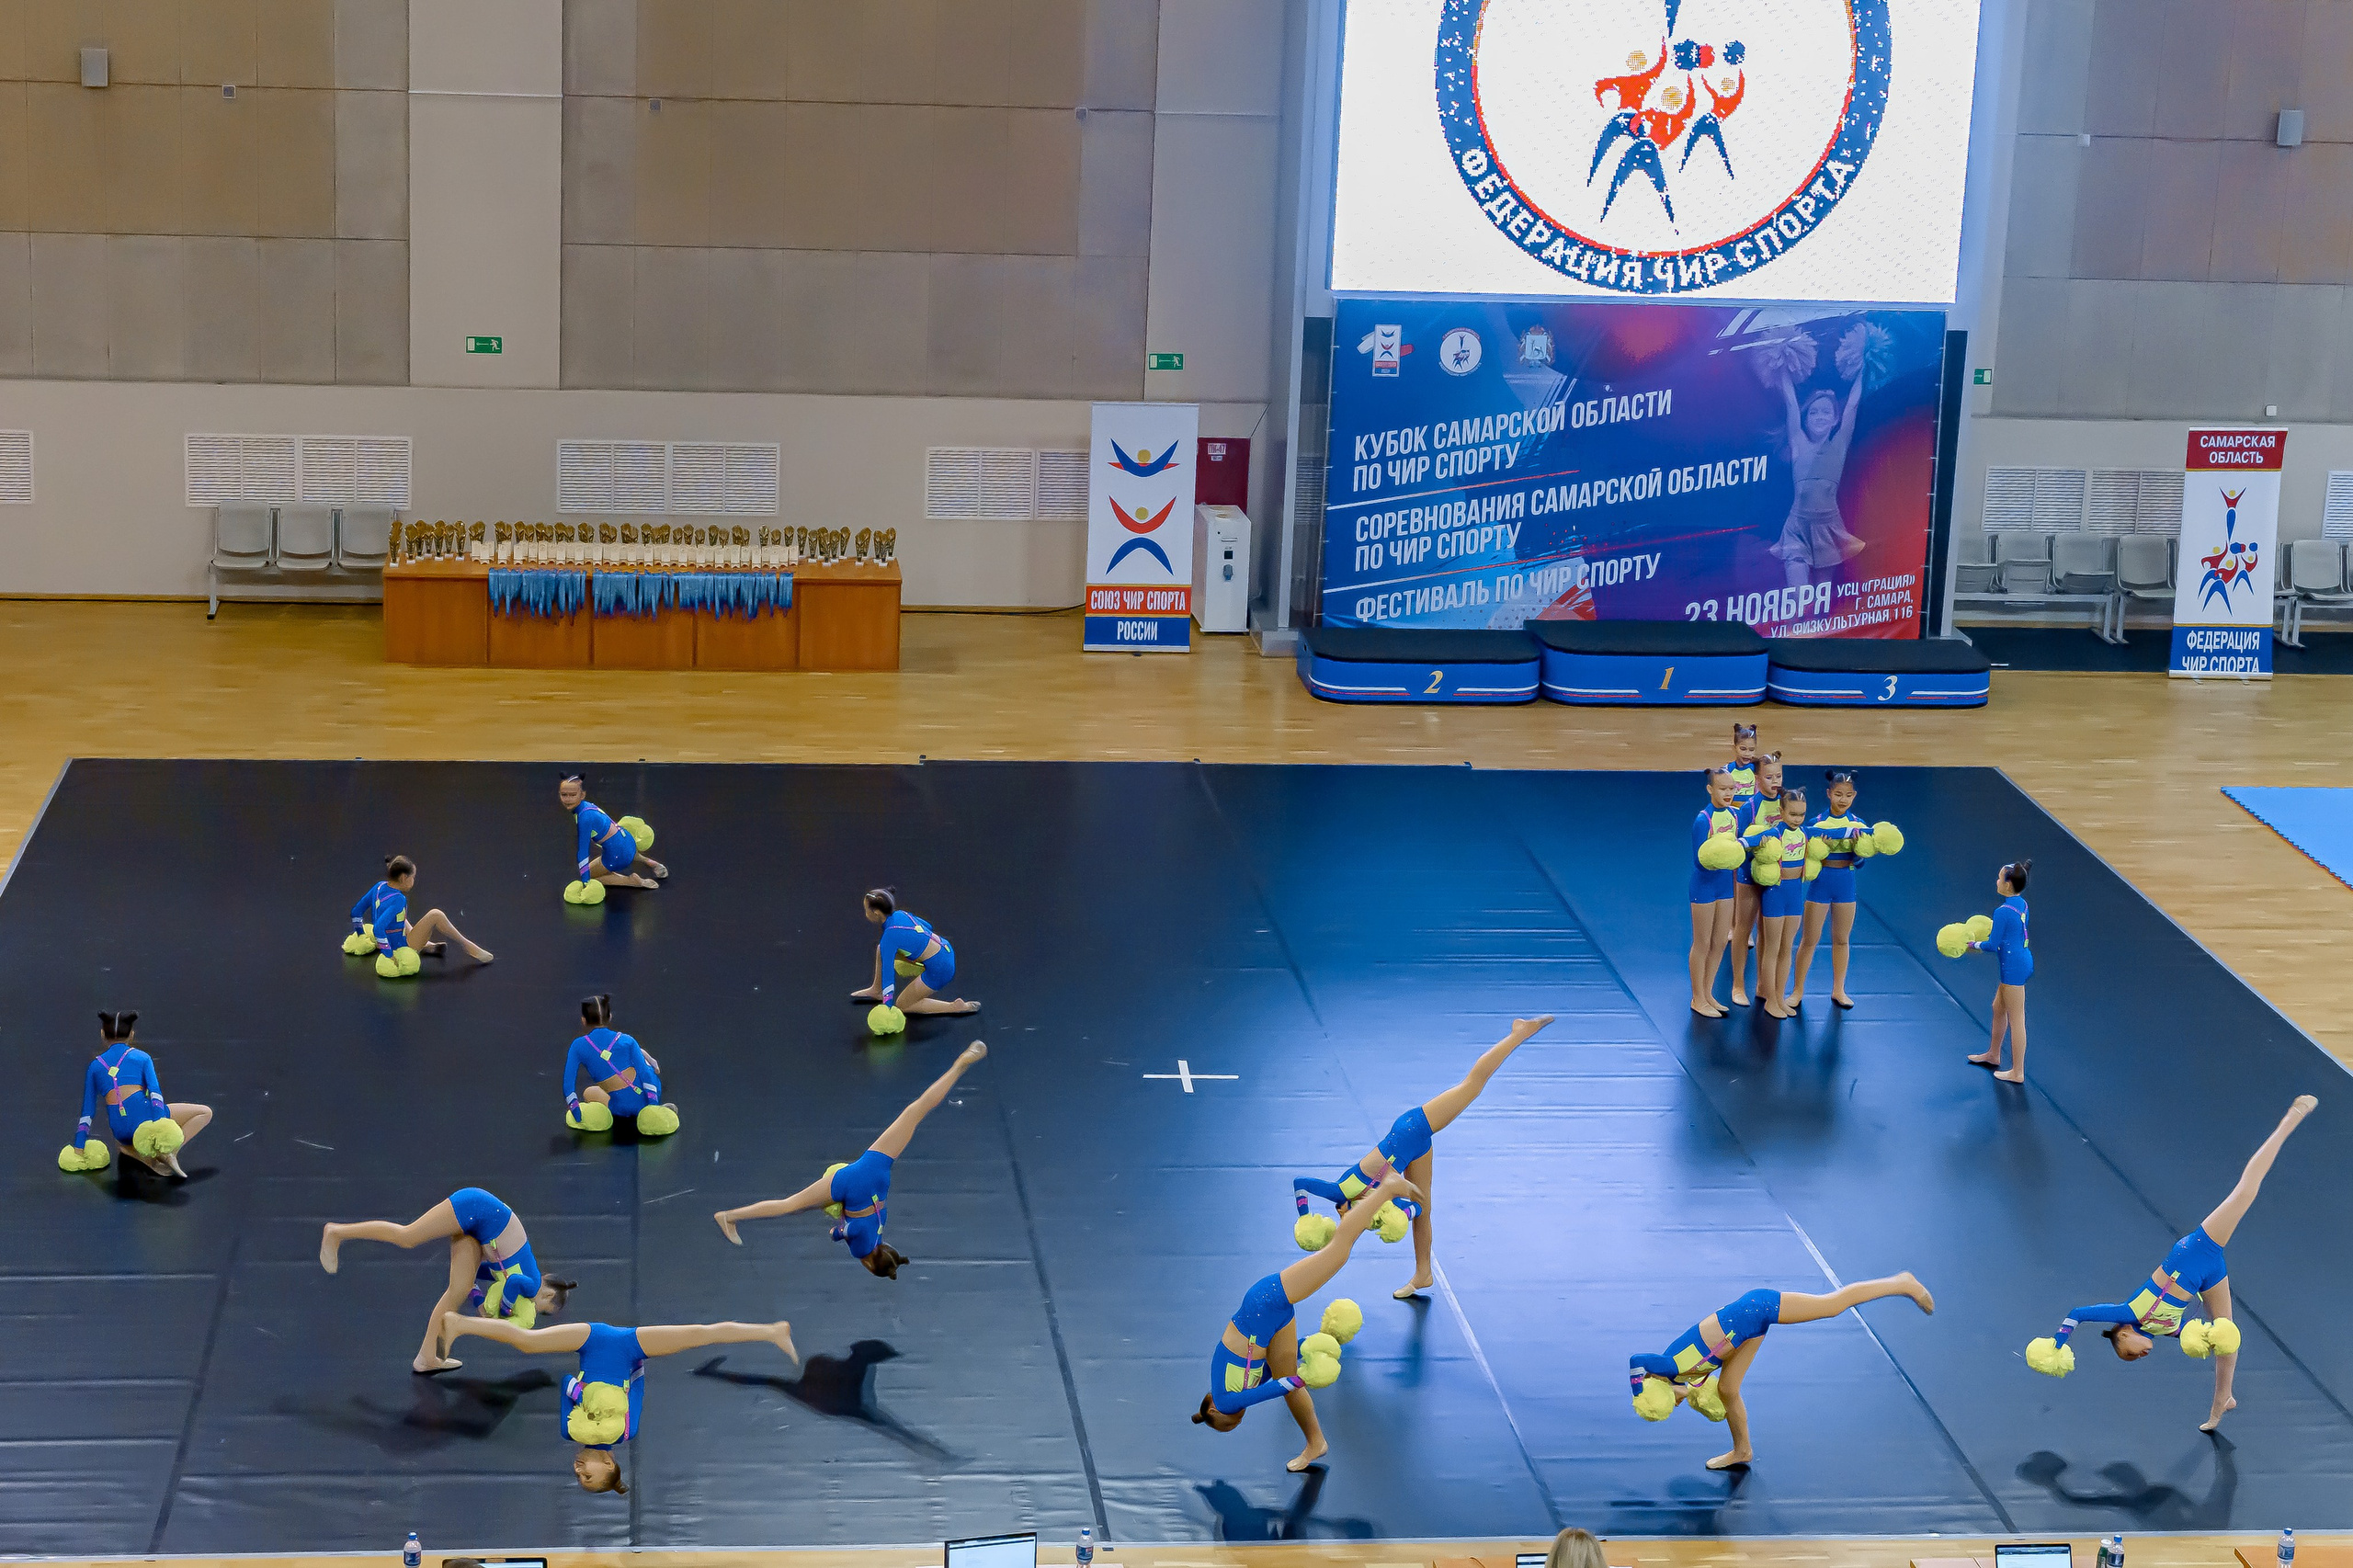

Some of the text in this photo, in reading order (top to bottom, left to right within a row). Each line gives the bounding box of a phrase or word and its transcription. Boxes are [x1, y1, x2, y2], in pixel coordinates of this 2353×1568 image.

[1462, 148, 1855, 293] ФЕДЕРАЦИЯ ЧИР СПОРТА
[1355, 389, 1672, 461] КУБОК САМАРСКОЙ ОБЛАСТИ
[2200, 435, 2276, 449] САМАРСКАЯ
[1353, 442, 1521, 492] ПО ЧИР СПОРТУ
[2209, 451, 2264, 464] ОБЛАСТЬ
[1356, 455, 1768, 542] СОРЕВНОВАНИЯ САМАРСКОЙ ОБЛАСТИ
[1355, 522, 1522, 572] ПО ЧИР СПОРТУ
[1356, 552, 1661, 622] ФЕСТИВАЛЬ ПО ЧИР СПОРТУ
[1837, 574, 1915, 597] УСЦ «ГРАЦИЯ»
[1090, 590, 1186, 611] СОЮЗ ЧИР СПОРТА
[1685, 582, 1831, 625] 23 НОЯБРЯ
[1855, 591, 1914, 610] Г. САМАРА,
[1117, 620, 1158, 641] РОССИИ
[1770, 605, 1913, 638] УЛ. ФИЗКУЛЬТУРНАЯ, 116
[2186, 630, 2260, 653] ФЕДЕРАЦИЯ
[2182, 655, 2259, 672] ЧИР СПОРТА
[1423, 670, 1444, 693] 2
[1659, 666, 1676, 689] 1
[1877, 675, 1898, 701] 3
